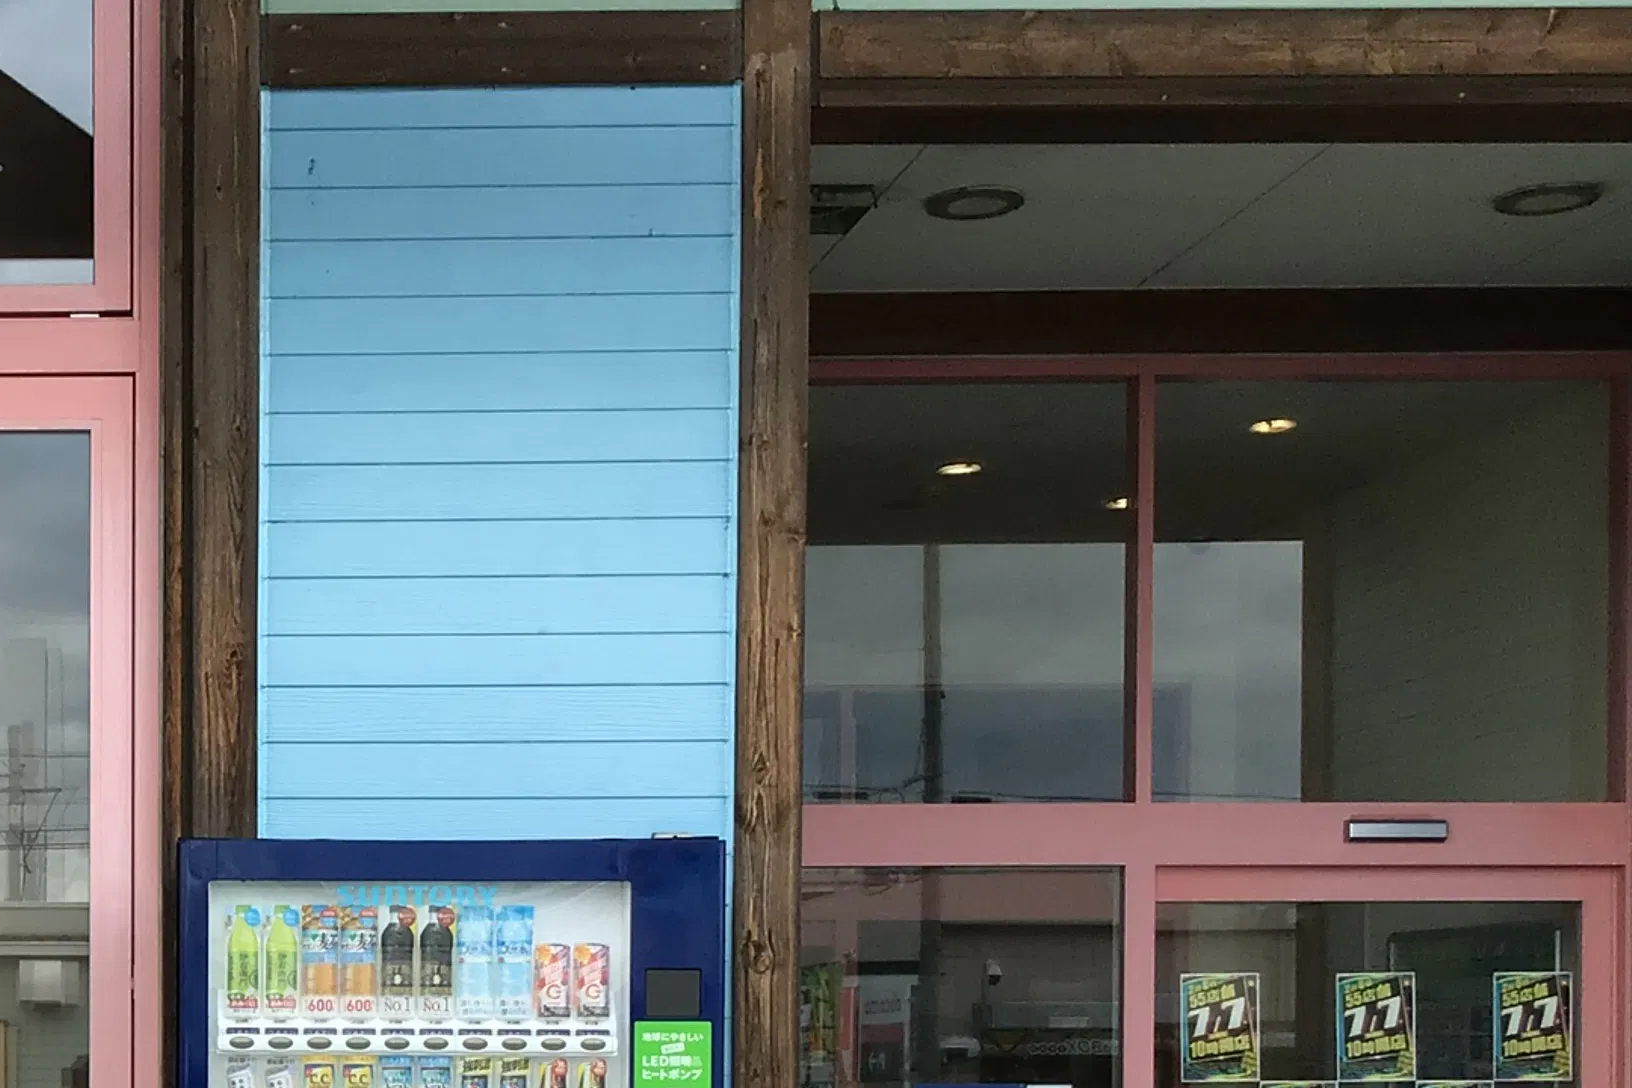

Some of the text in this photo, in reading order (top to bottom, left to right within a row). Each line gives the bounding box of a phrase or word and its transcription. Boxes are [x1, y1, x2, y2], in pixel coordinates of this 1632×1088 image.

[336, 884, 497, 905] SUNTORY
[308, 1001, 333, 1012] 600
[347, 1001, 372, 1012] 600
